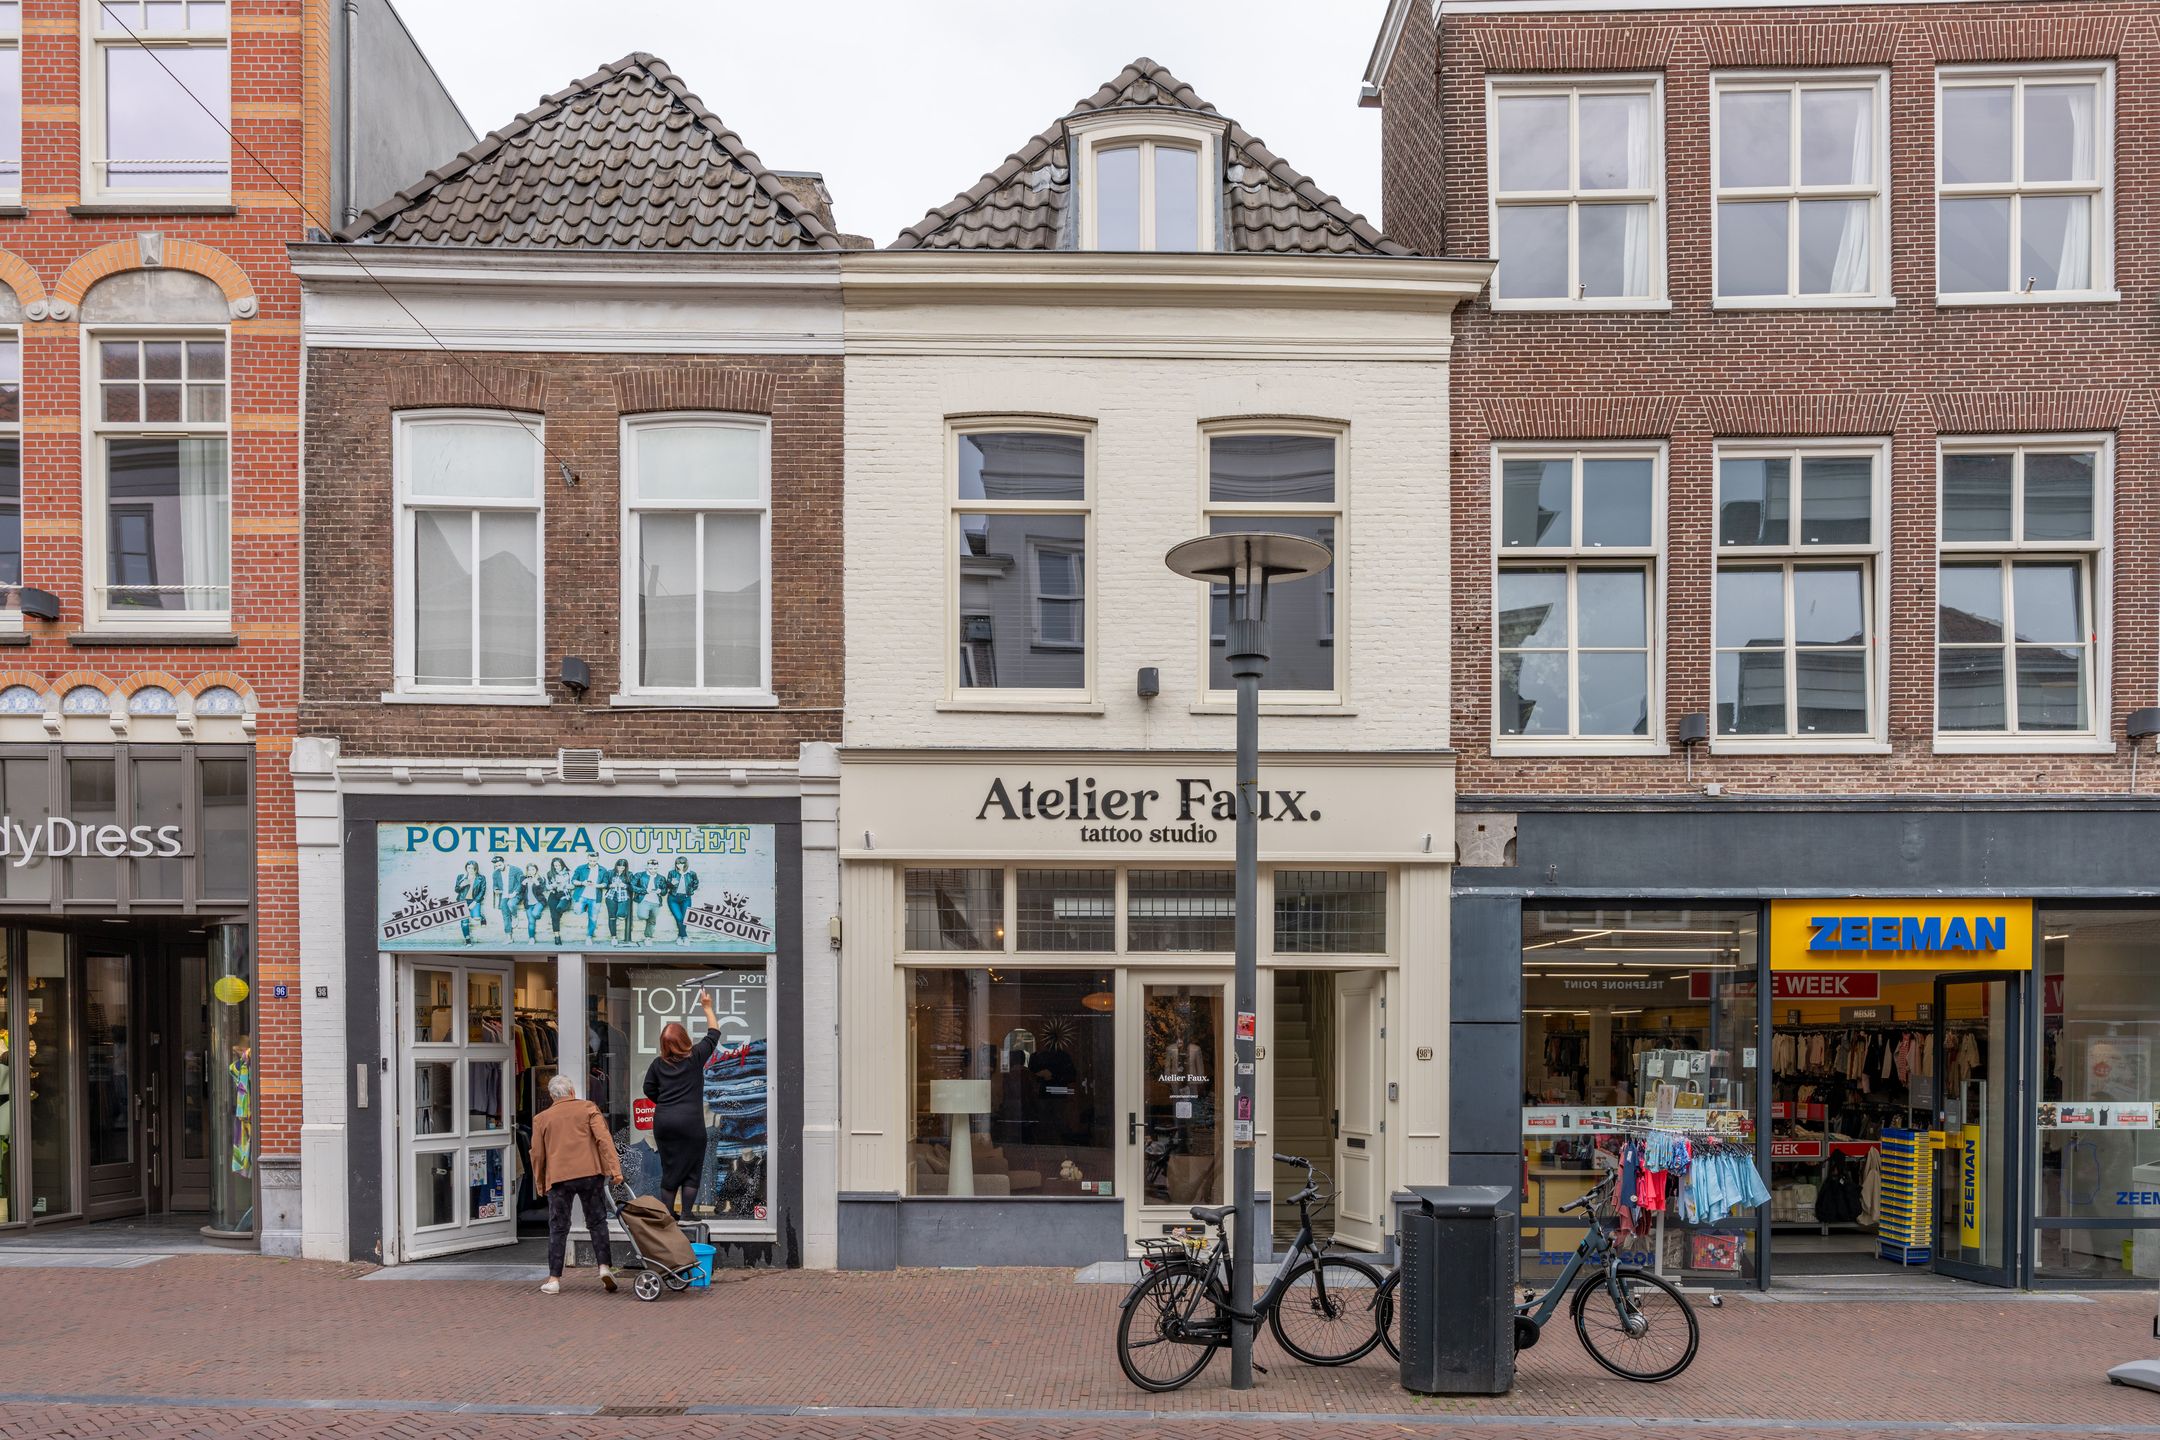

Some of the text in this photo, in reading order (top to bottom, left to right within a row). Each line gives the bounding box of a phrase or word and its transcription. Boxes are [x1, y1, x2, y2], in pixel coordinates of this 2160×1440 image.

[975, 777, 1159, 821] Atelier
[406, 826, 750, 854] POTENZA OUTLET
[1080, 822, 1217, 843] tattoo studio
[402, 897, 443, 919] DAYS
[711, 902, 753, 924] DAYS
[384, 904, 467, 939] DISCOUNT
[686, 910, 771, 944] DISCOUNT
[1808, 916, 2006, 951] ZEEMAN
[275, 986, 286, 996] 96
[1786, 976, 1850, 995] WEEK
[632, 987, 747, 1015] TOTALE
[1853, 1009, 1877, 1019] MEISJES
[1158, 1074, 1210, 1082] Atelier Faux.
[1963, 1139, 1975, 1230] ZEEMAN
